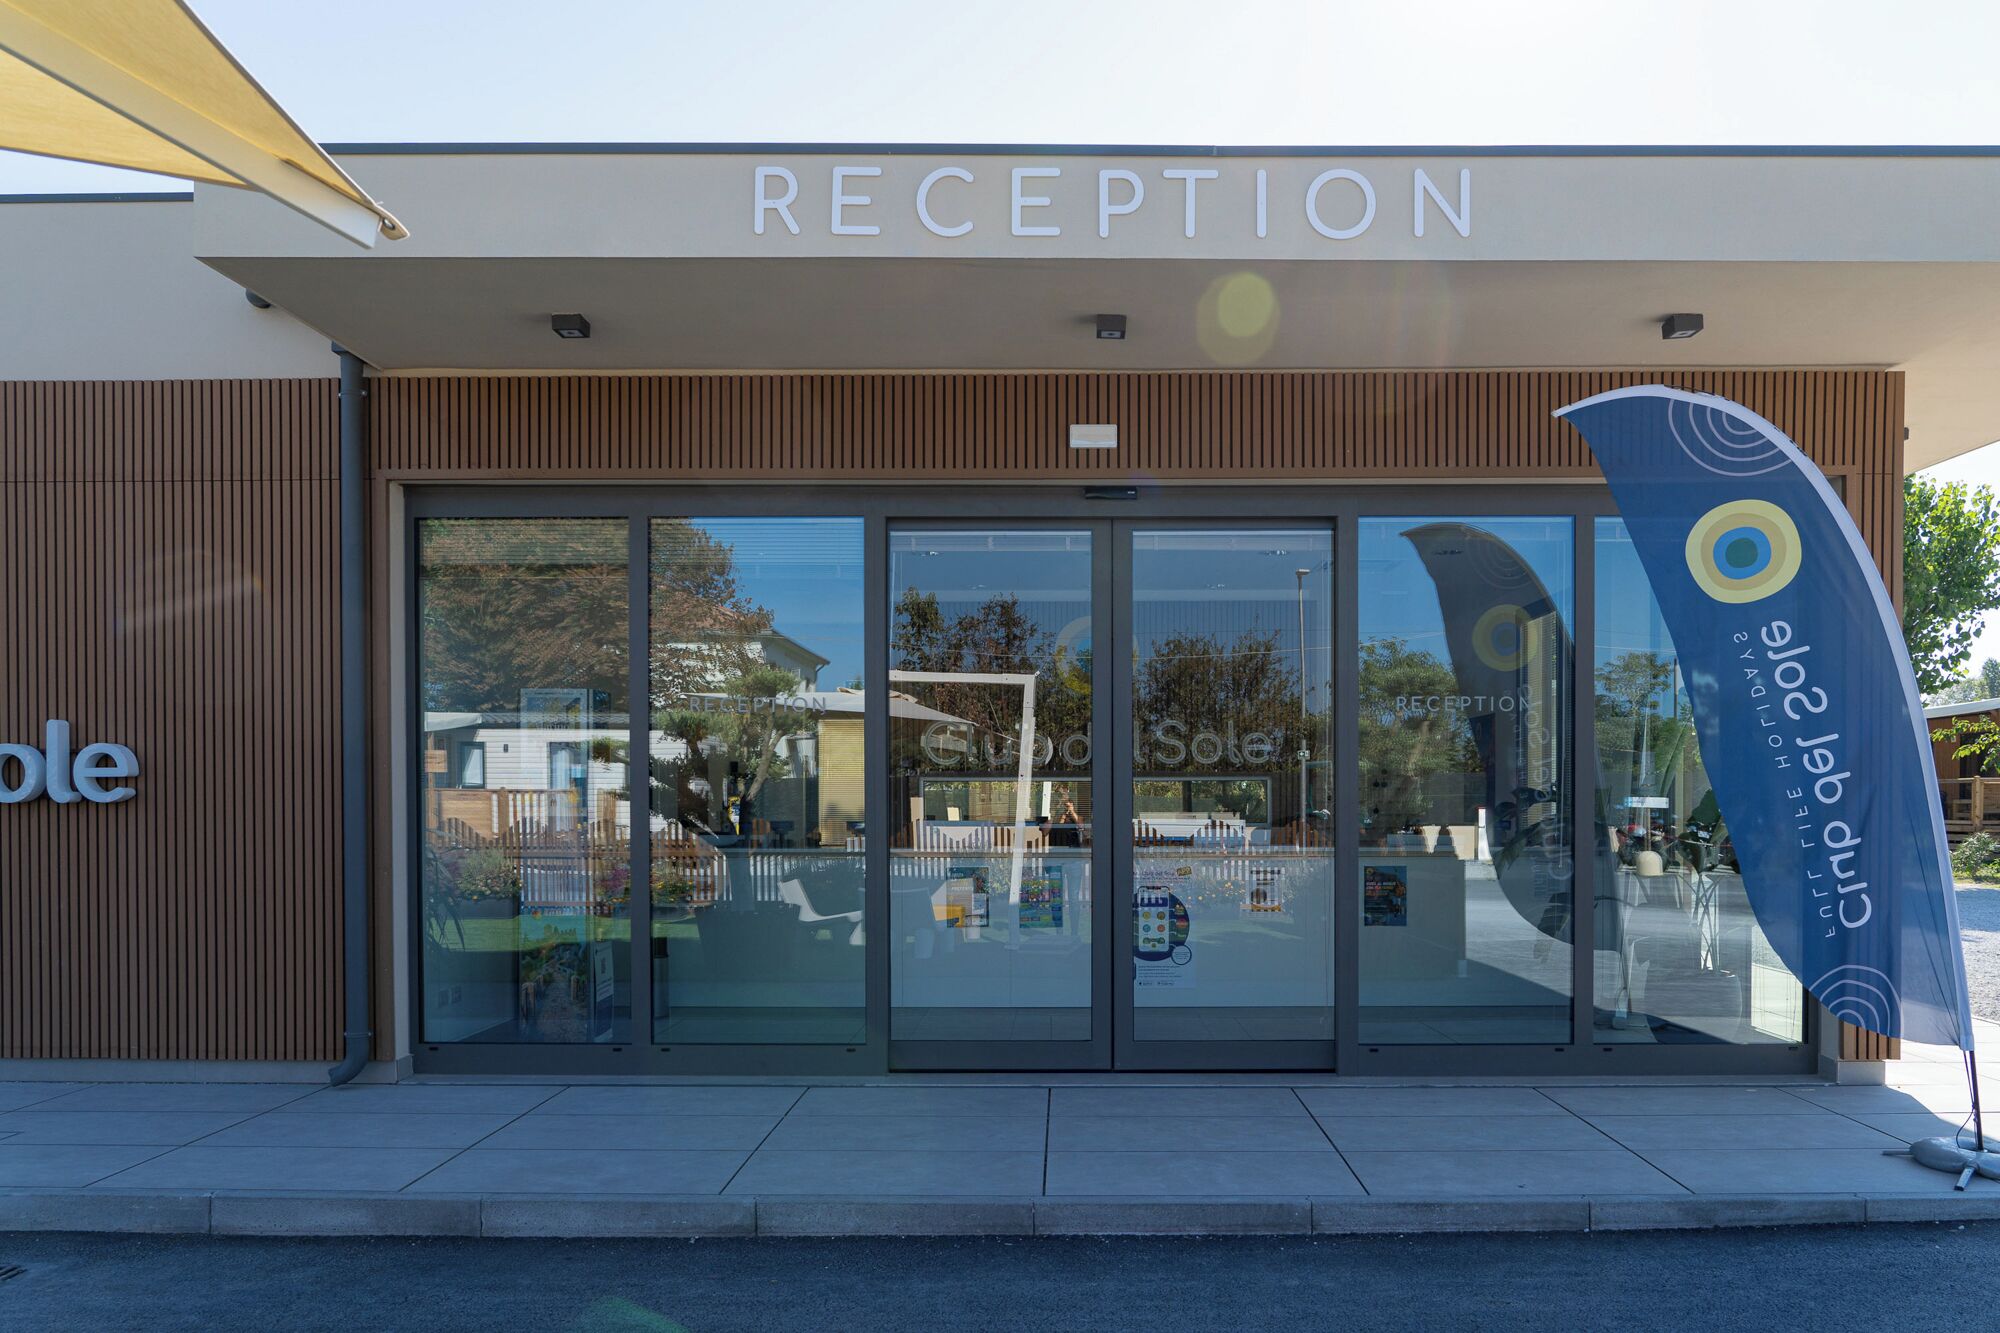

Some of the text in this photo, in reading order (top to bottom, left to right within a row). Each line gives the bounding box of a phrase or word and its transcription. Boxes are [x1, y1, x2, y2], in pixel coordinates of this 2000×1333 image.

[752, 166, 1471, 240] RECEPTION
[689, 696, 827, 714] RECEPTION
[1396, 696, 1531, 712] RECEPTION
[0, 719, 139, 804] ole
[1063, 721, 1146, 765] dl
[1156, 719, 1271, 765] Sole
